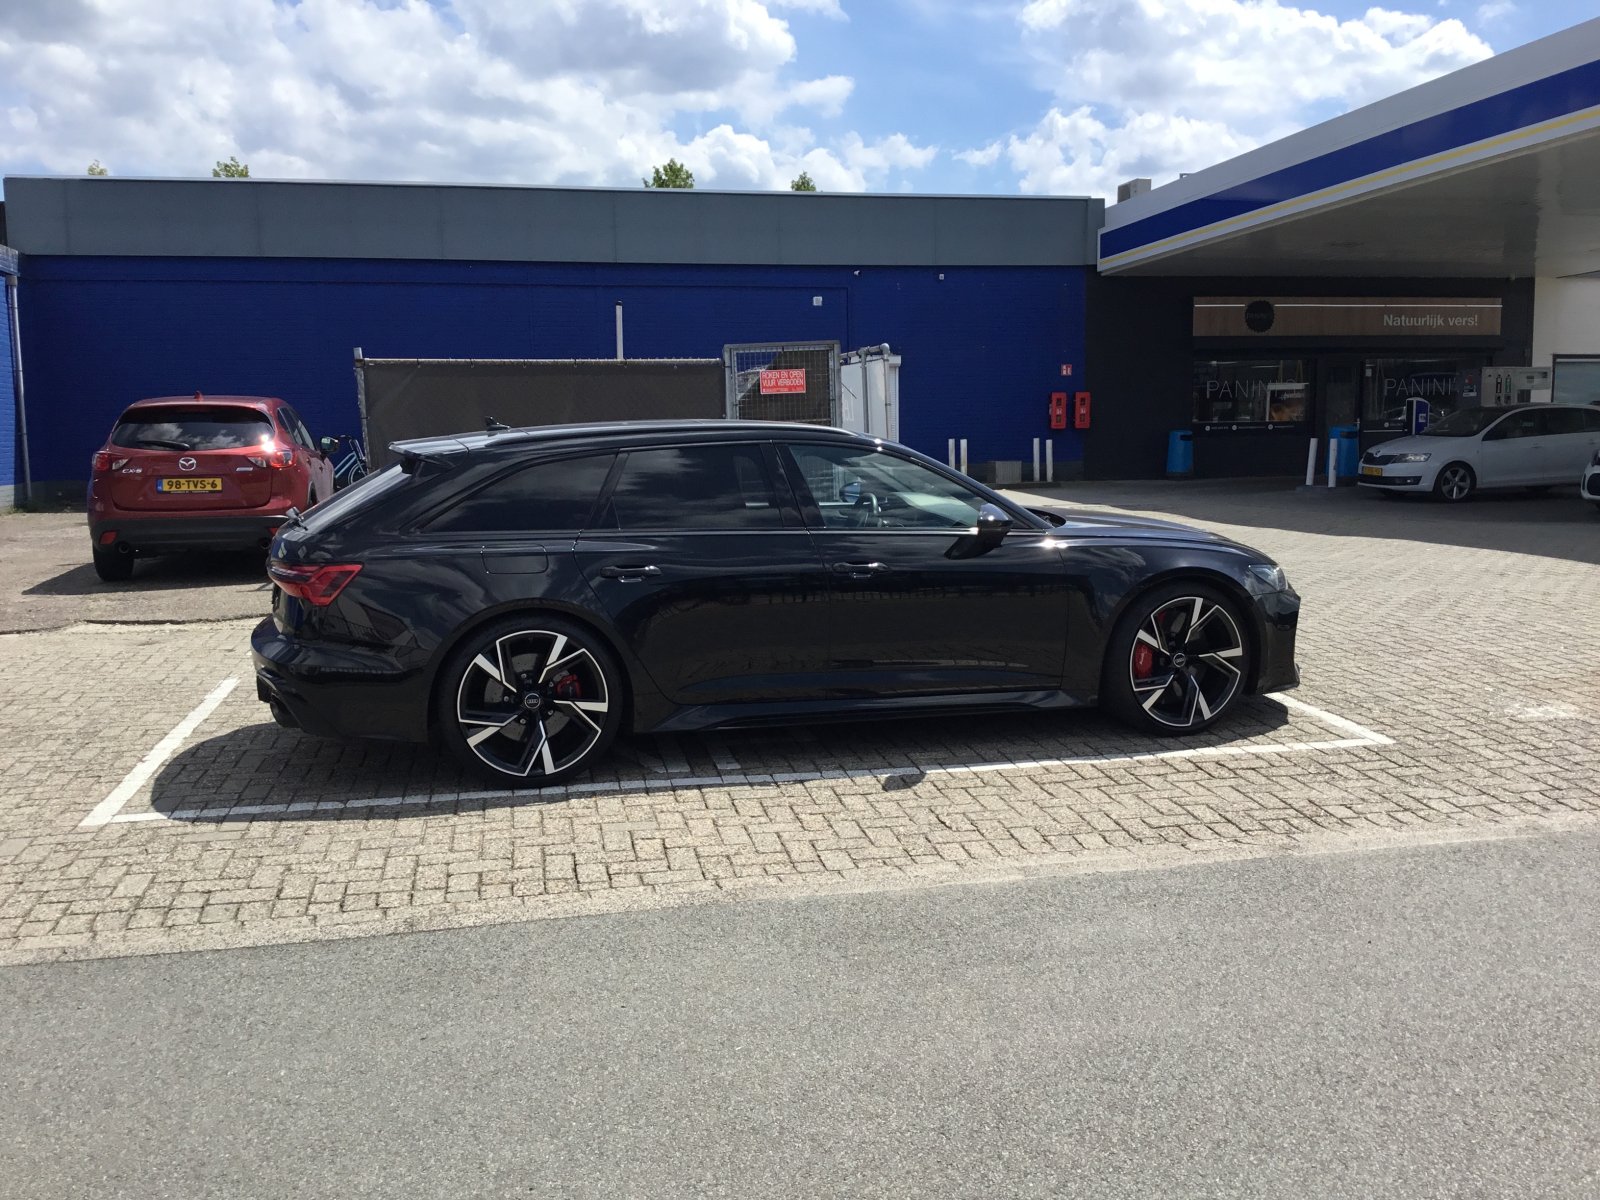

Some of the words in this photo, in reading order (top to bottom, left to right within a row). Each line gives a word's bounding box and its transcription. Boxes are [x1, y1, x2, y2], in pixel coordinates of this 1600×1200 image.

[1383, 314, 1444, 328] Natuurlijk
[1448, 314, 1478, 326] vers!
[167, 480, 218, 490] 98-TVS-6
